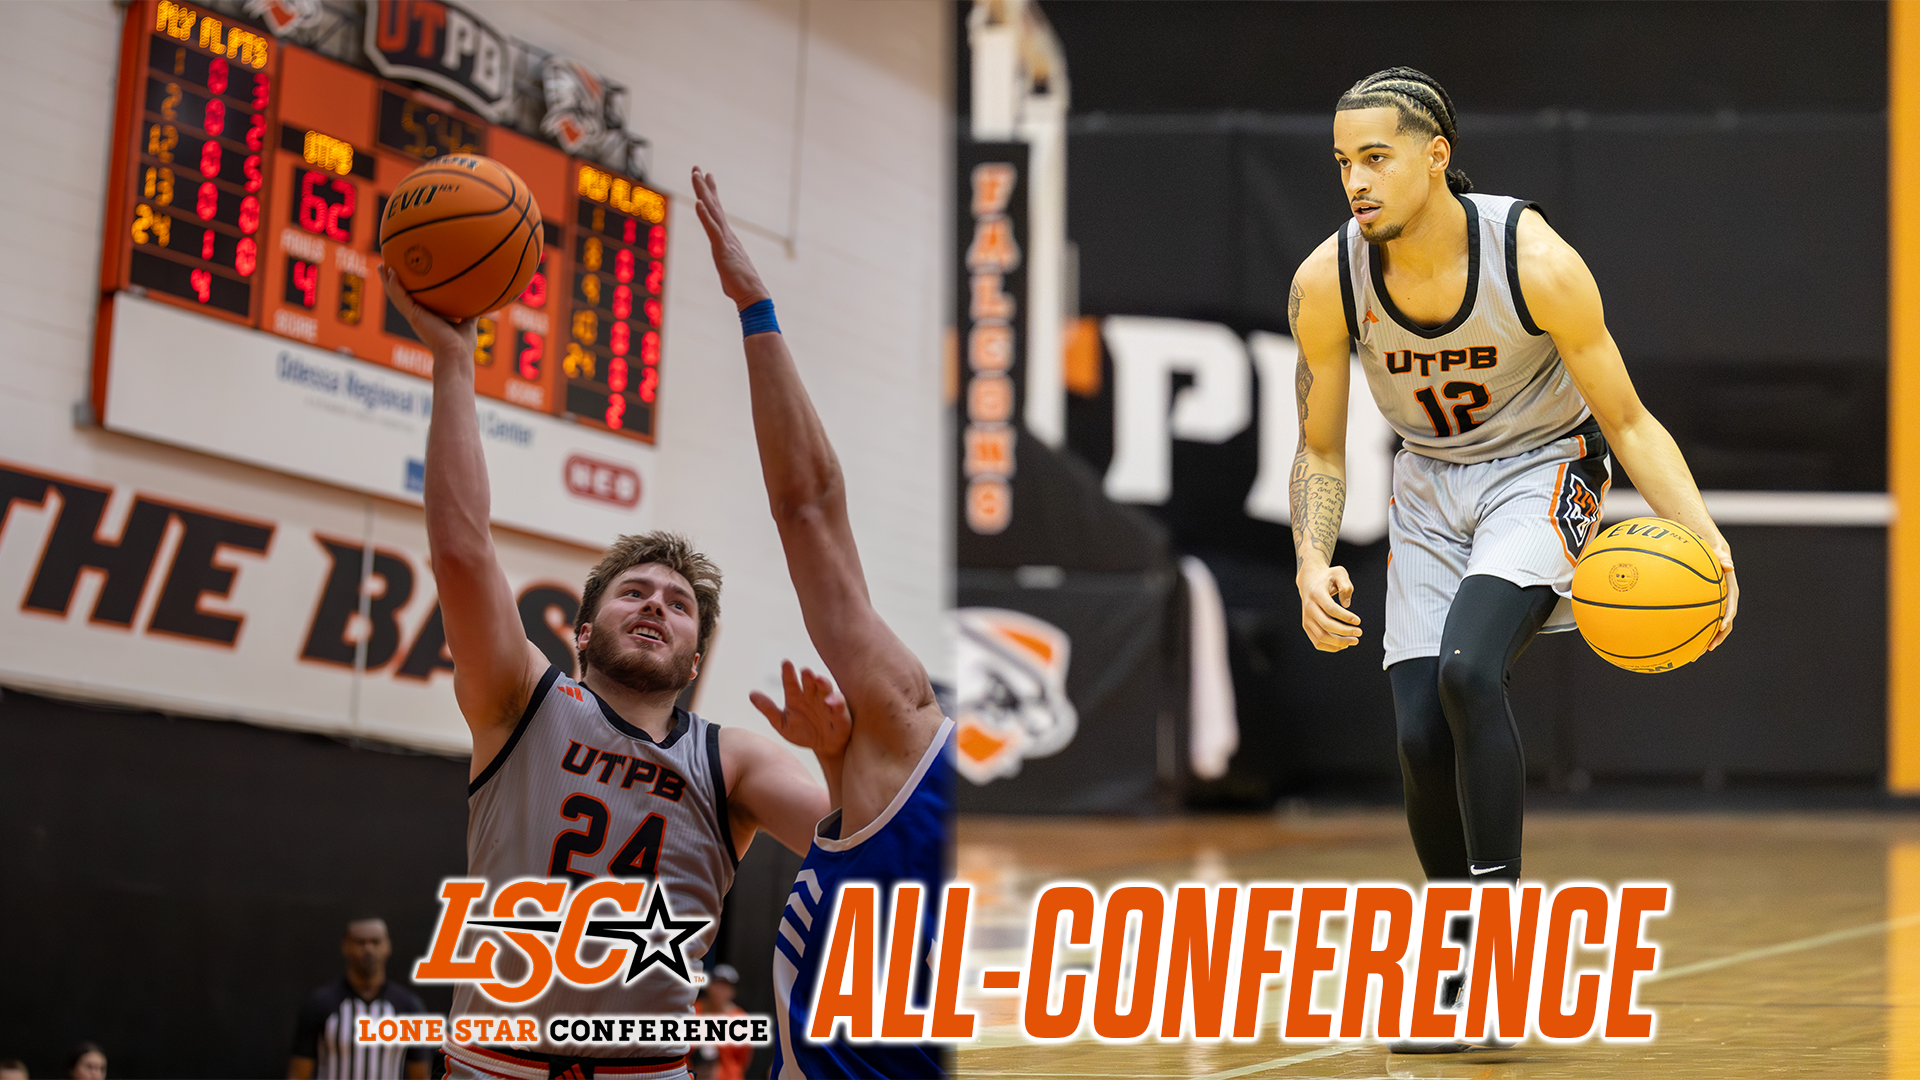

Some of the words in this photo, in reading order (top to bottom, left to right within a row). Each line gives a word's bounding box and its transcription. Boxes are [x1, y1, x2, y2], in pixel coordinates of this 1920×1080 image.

[376, 0, 501, 98] UTPB
[161, 82, 182, 121] 2
[245, 113, 267, 152] 2
[251, 73, 270, 111] 3
[131, 203, 171, 247] 24
[299, 170, 356, 243] 62
[387, 184, 439, 220] EVO
[293, 260, 318, 308] 4
[339, 271, 363, 325] 3
[519, 331, 543, 380] 2
[1383, 345, 1498, 377] UTPB
[605, 393, 626, 430] 2
[1063, 314, 1396, 546] PB
[1413, 380, 1492, 438] 12
[1607, 523, 1671, 540] EVO
[1670, 532, 1690, 545] NXT
[561, 738, 688, 804] UTPB
[547, 792, 668, 890] 24
